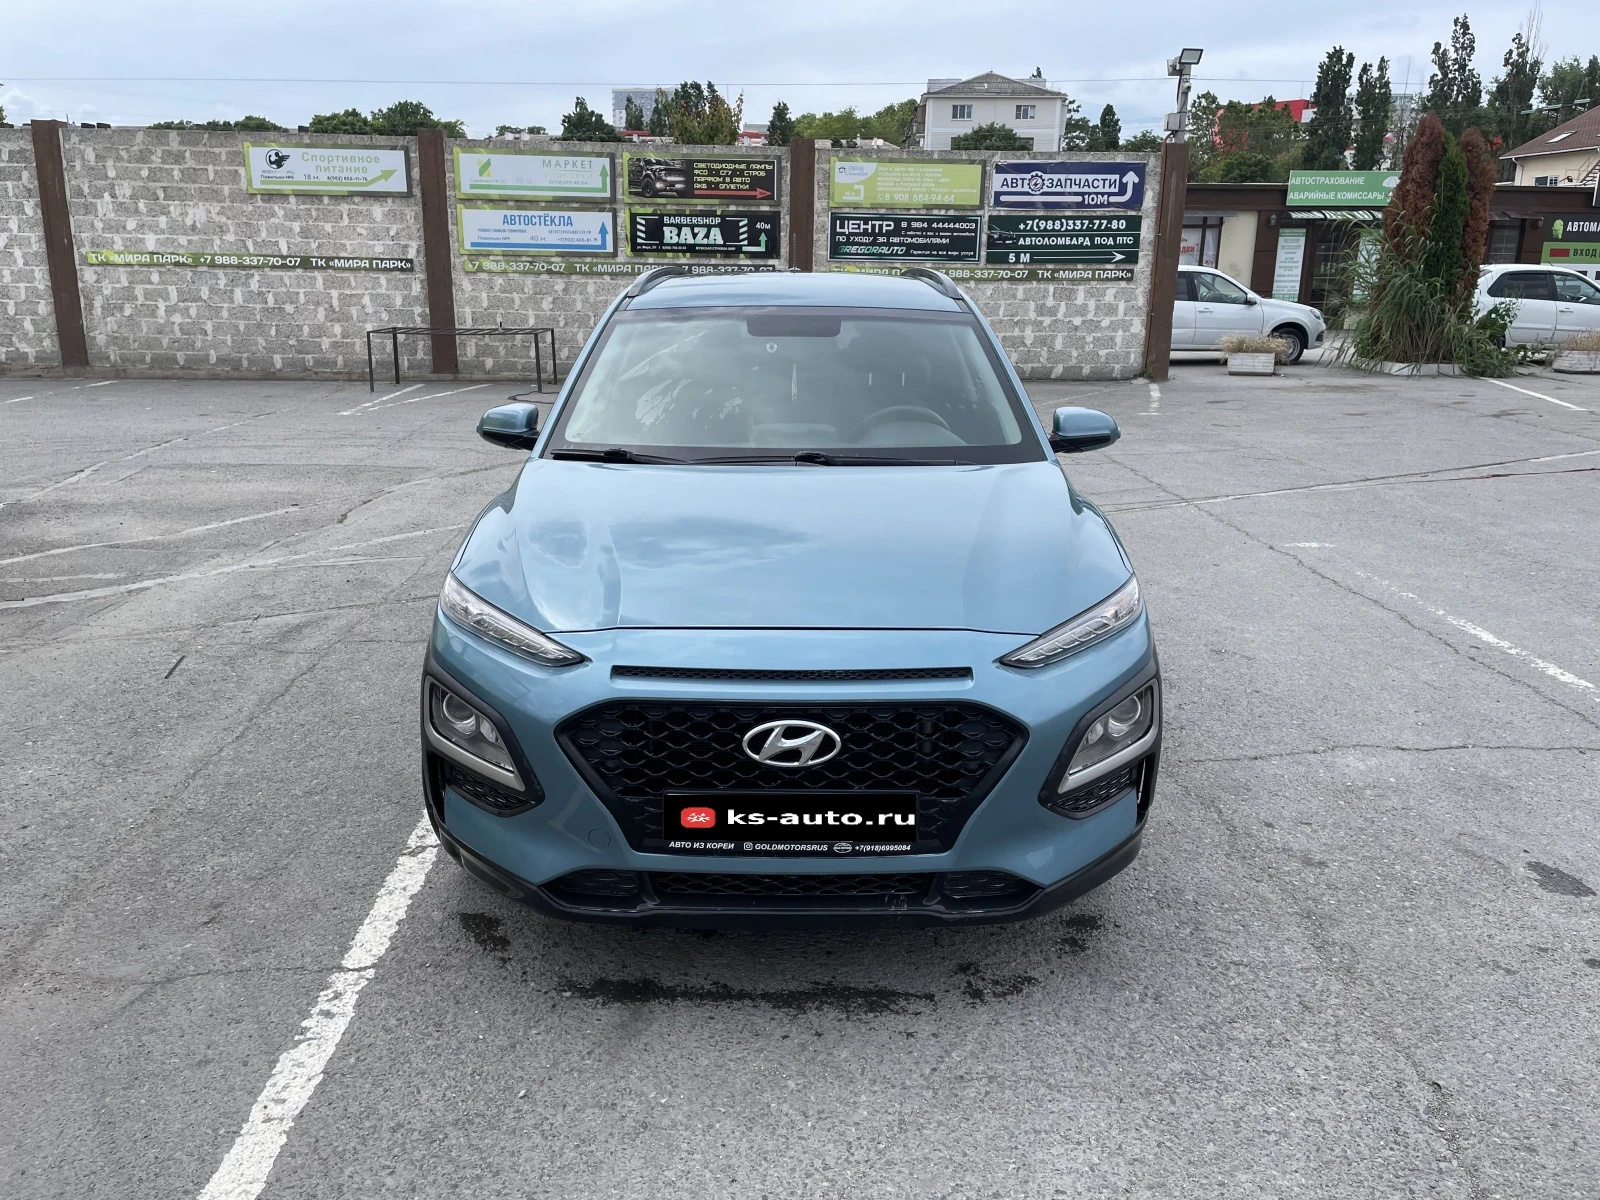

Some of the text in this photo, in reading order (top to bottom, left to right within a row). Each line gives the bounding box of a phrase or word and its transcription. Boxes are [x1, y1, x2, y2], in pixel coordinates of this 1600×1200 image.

[302, 152, 380, 164] Спортивное
[542, 159, 593, 169] МАРКЕТ
[316, 165, 368, 174] питание
[1289, 190, 1335, 199] АВАРИЙНЫЕ
[503, 214, 573, 227] АВТОСТЁКЛА
[664, 216, 721, 225] BARBERSHOP
[1019, 219, 1126, 231] +7(988)337-77-80
[836, 220, 894, 234] ЦЕНТР
[663, 227, 723, 244] BAZA
[1018, 237, 1090, 246] АВТОЛОМБАРД
[838, 246, 906, 254] GREGORAUTO
[1573, 249, 1597, 258] ВХОД
[90, 254, 106, 262] ТК
[109, 254, 150, 263] «МИРА
[154, 255, 192, 264] ПАРК»
[215, 256, 300, 266] 988-337-70-07
[310, 258, 326, 267] ТК
[329, 259, 369, 268] «МИРА
[373, 260, 411, 268] ПАРК»
[1009, 254, 1015, 262] 5
[483, 262, 565, 271] 988-337-70-07
[593, 264, 631, 273] «МИРА
[692, 266, 773, 274] 988-337-7007
[949, 270, 1028, 278] 988-337-70-07
[1054, 270, 1092, 278] «МИРА
